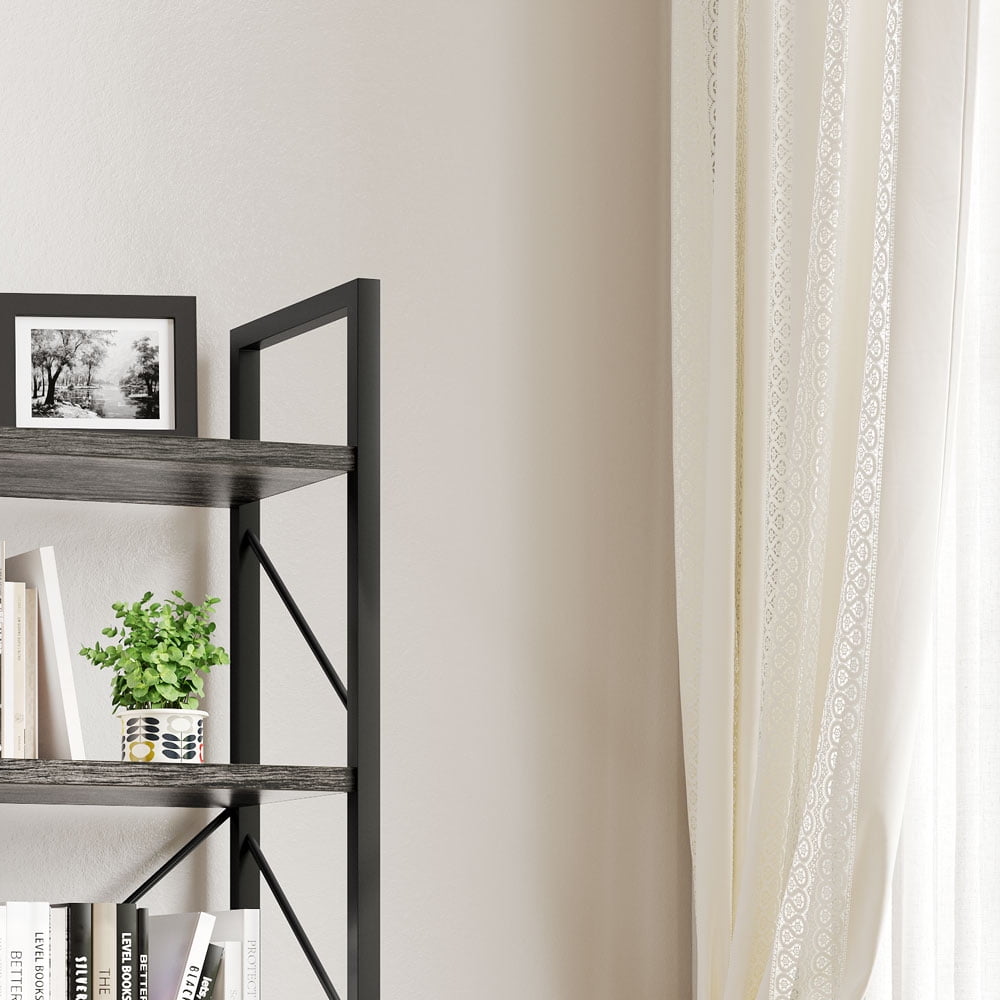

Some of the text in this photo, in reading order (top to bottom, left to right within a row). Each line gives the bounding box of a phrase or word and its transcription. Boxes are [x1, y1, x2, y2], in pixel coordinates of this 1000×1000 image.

[35, 933, 43, 962] LEVEL
[122, 933, 131, 963] LEVEL
[35, 966, 44, 1000] BOOKS
[76, 956, 87, 1000] SILVER
[99, 969, 110, 994] THE
[122, 966, 131, 1000] BOOKS
[196, 977, 212, 999] lets,
